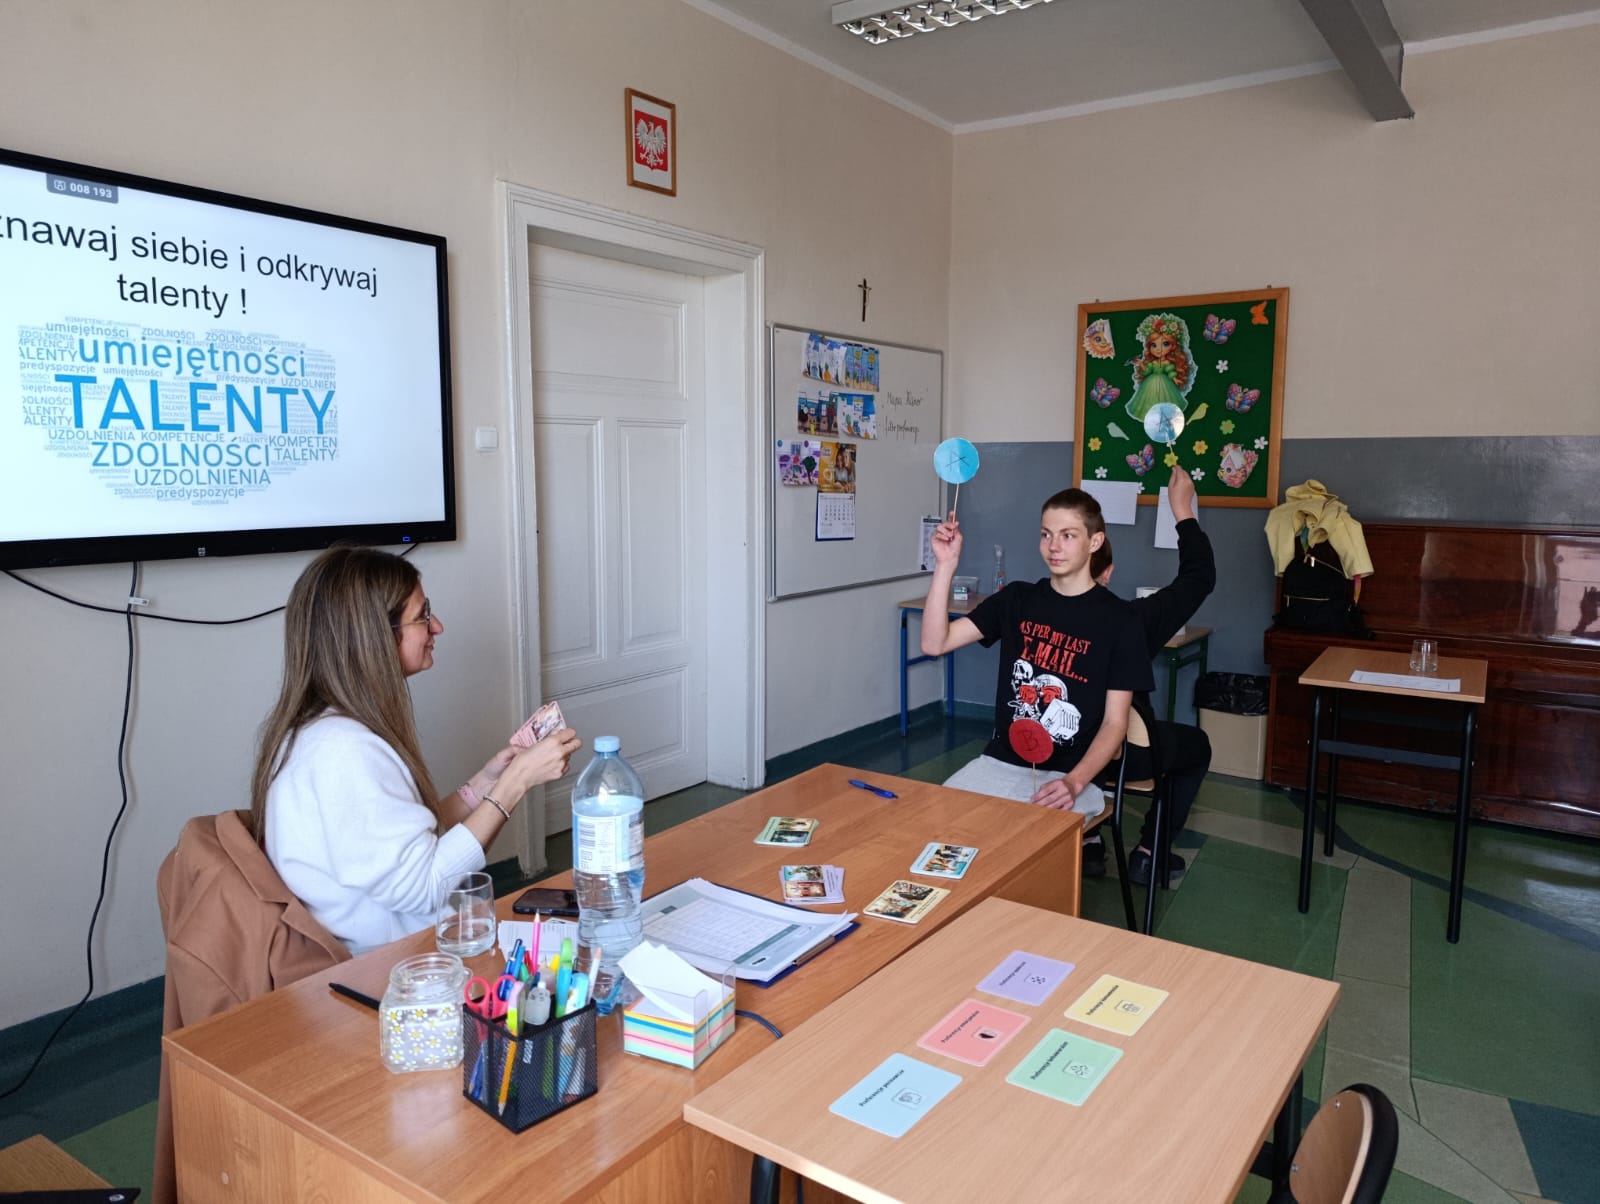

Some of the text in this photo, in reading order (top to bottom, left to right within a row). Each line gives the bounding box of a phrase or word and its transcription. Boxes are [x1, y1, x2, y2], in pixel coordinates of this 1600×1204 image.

[70, 184, 113, 199] 008 193
[0, 216, 378, 298] nawaj siebie i odkrywaj
[117, 273, 247, 319] talenty !
[46, 322, 130, 338] umiejętności
[78, 335, 306, 378] umiejętności
[54, 373, 336, 435] TALENTY
[48, 429, 136, 442] UZDOLNIENIA
[141, 431, 225, 444] KOMPETENCJE
[91, 436, 271, 467] ZDOLNOŚCI
[274, 448, 337, 462] TALENTY
[134, 468, 272, 486] UZDOLNIENIA
[156, 487, 246, 500] predyspozycje
[1032, 623, 1051, 639] PER
[1050, 630, 1067, 647] MY
[1064, 635, 1092, 656] LAST
[1021, 729, 1039, 752] B
